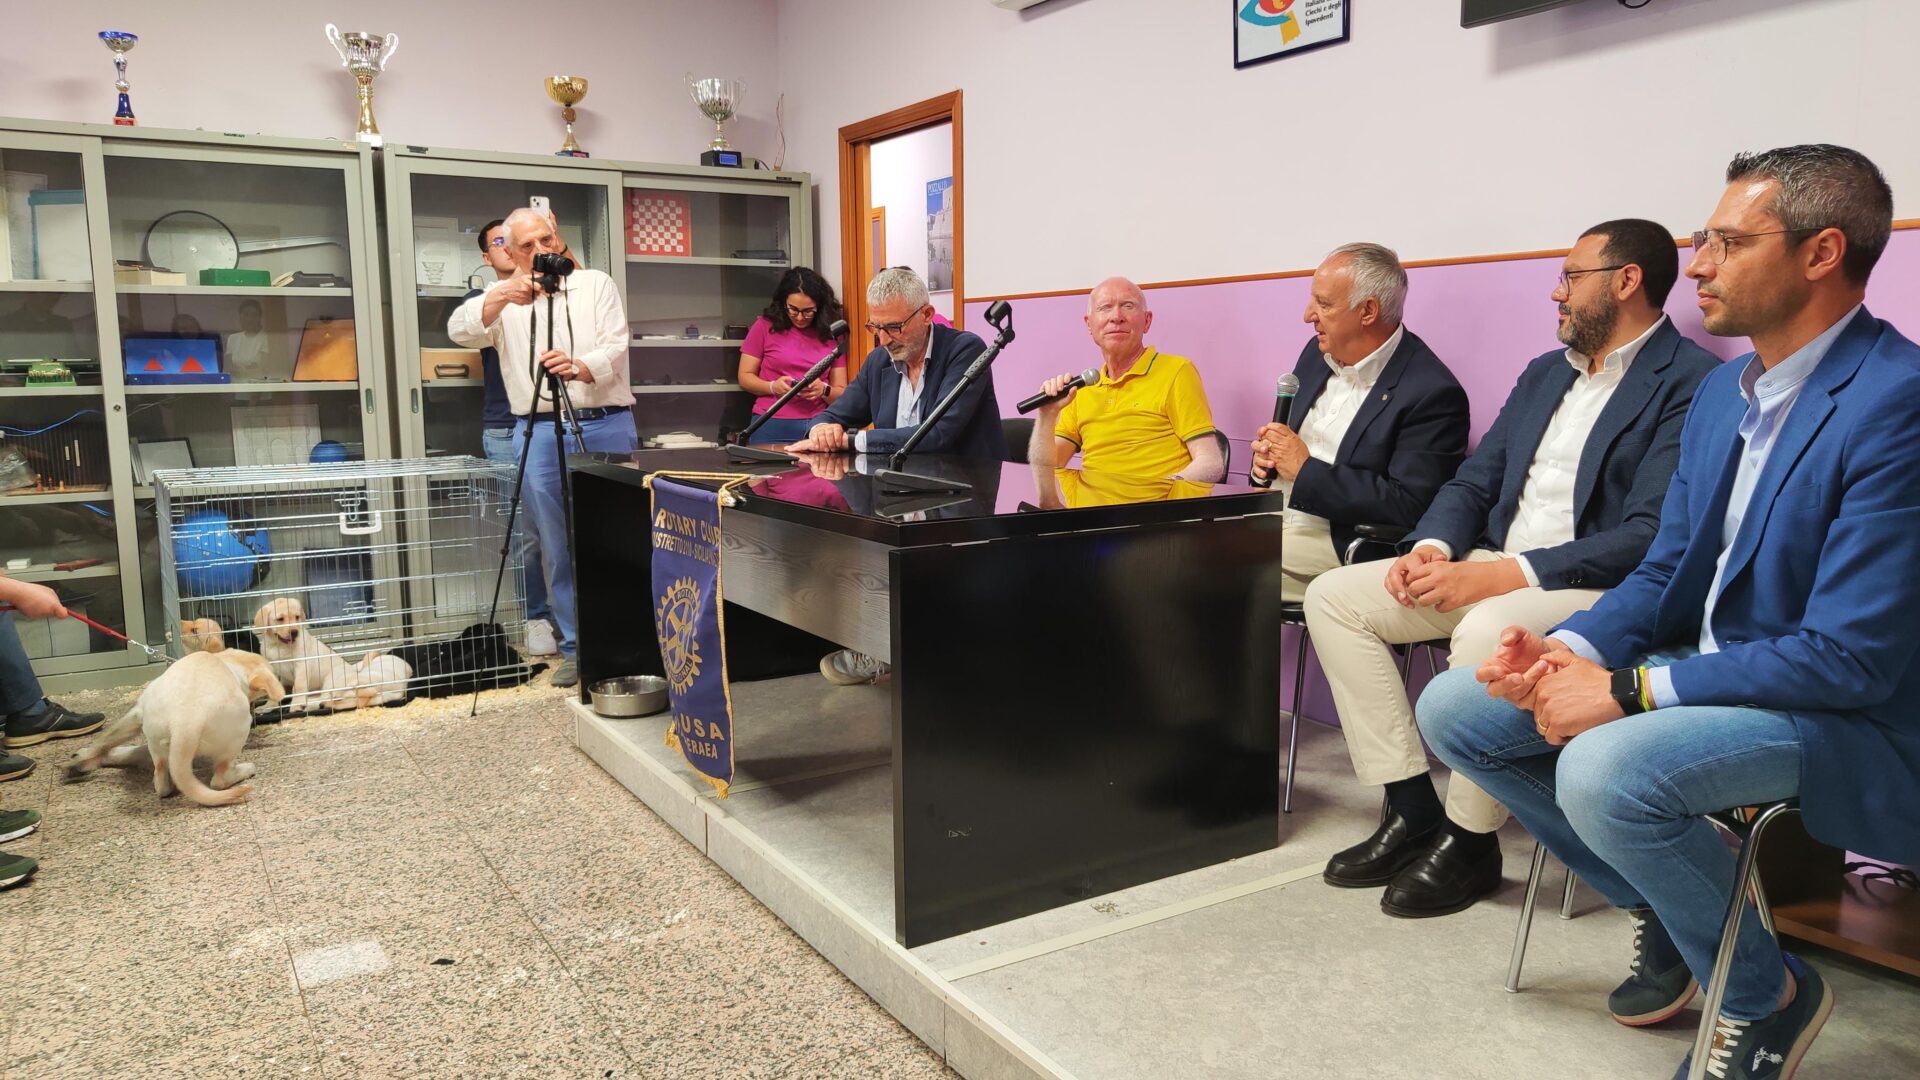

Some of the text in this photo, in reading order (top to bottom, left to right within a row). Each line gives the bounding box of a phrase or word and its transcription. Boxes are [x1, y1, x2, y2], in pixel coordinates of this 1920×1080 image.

[1305, 6, 1322, 16] Ciechi
[1328, 0, 1341, 10] degli
[1305, 11, 1333, 27] Ipovedenti
[654, 507, 720, 547] ROTARY CLUB
[677, 713, 725, 741] USA
